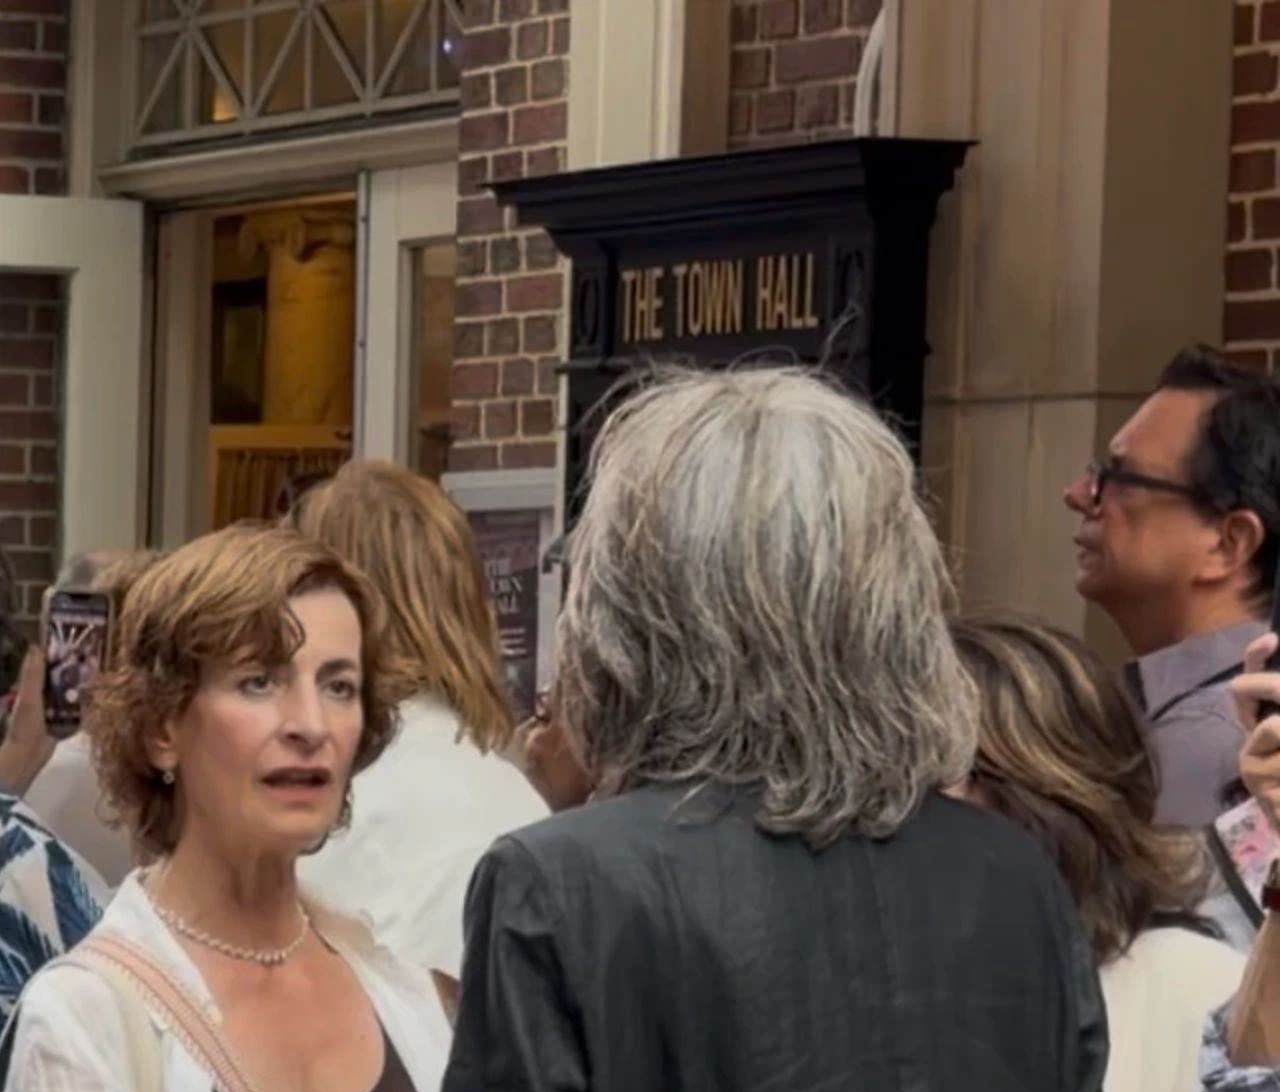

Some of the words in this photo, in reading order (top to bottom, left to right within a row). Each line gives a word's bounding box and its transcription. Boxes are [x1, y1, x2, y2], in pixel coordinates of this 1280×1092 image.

[621, 267, 664, 343] THE
[671, 258, 743, 338] TOWN
[755, 252, 819, 331] HALL
